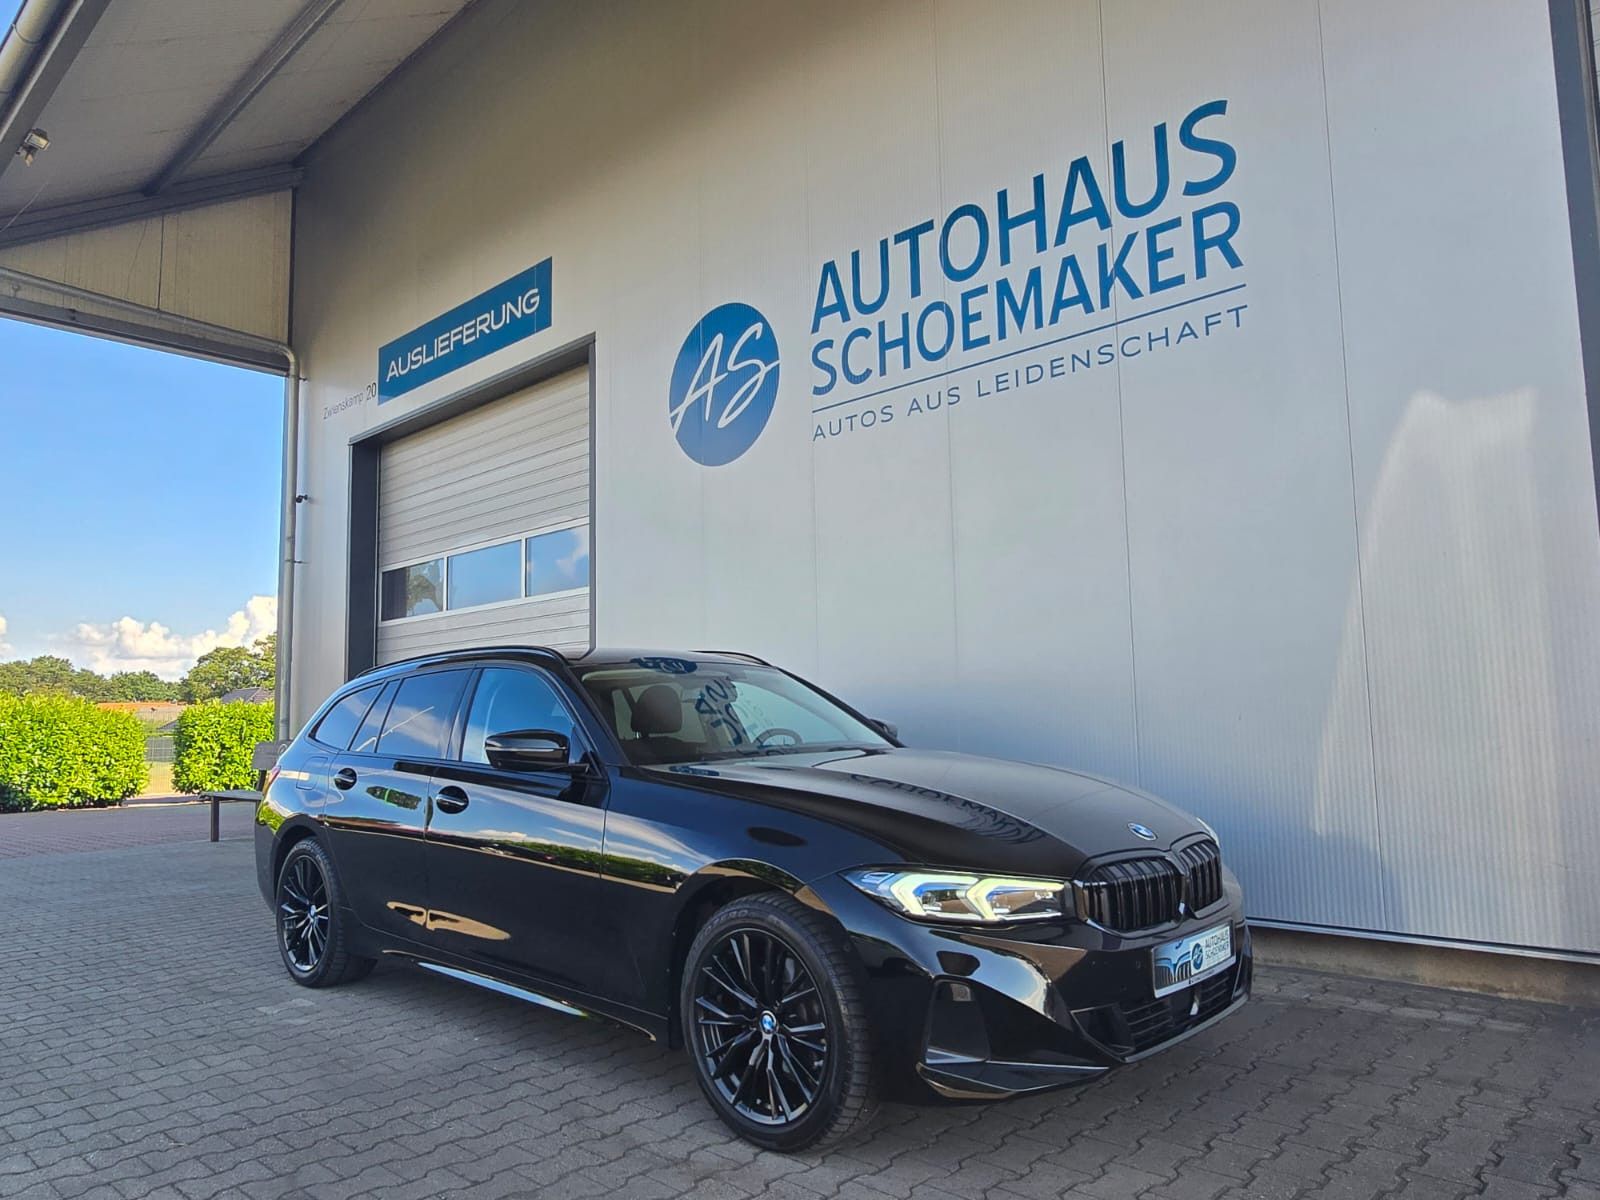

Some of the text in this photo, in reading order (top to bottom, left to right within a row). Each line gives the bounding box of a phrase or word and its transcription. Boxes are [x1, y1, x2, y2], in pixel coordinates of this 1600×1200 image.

[811, 100, 1237, 334] AUTOHAUS
[386, 288, 540, 382] AUSLIEFERUNG
[811, 201, 1244, 396] SCHOEMAKER
[366, 382, 377, 400] 20
[669, 322, 780, 433] AS
[812, 305, 1248, 442] AUTOS AUS LEIDENSCHAFT
